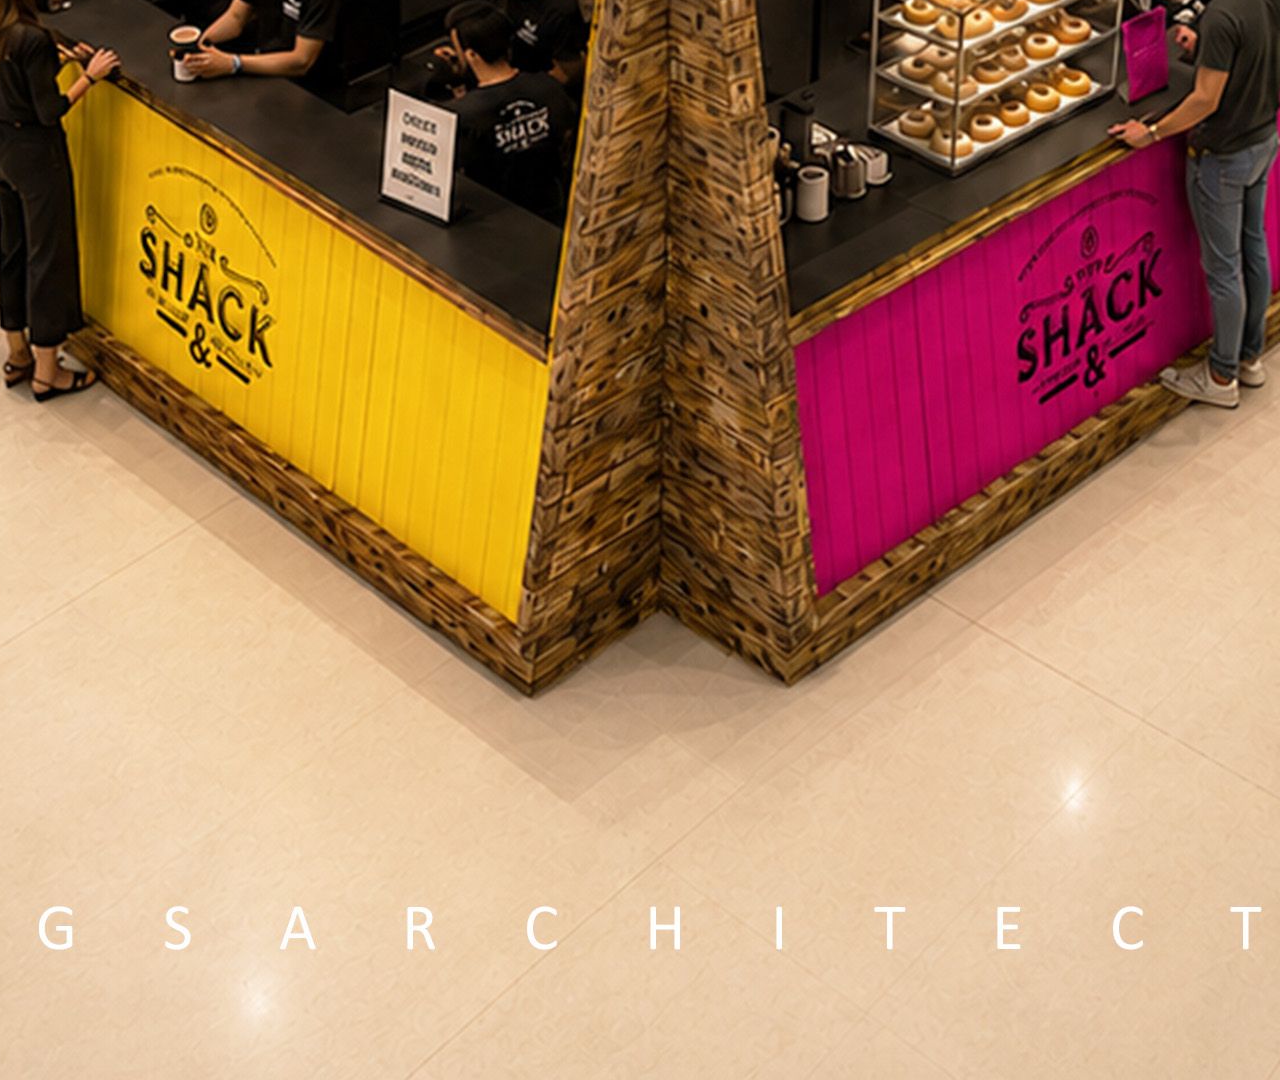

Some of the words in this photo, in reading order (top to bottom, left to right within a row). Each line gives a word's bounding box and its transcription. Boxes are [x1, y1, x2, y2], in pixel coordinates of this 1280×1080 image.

[138, 225, 274, 367] SHACK
[1016, 247, 1163, 384] SHACK
[188, 322, 213, 369] &
[1082, 343, 1106, 389] &
